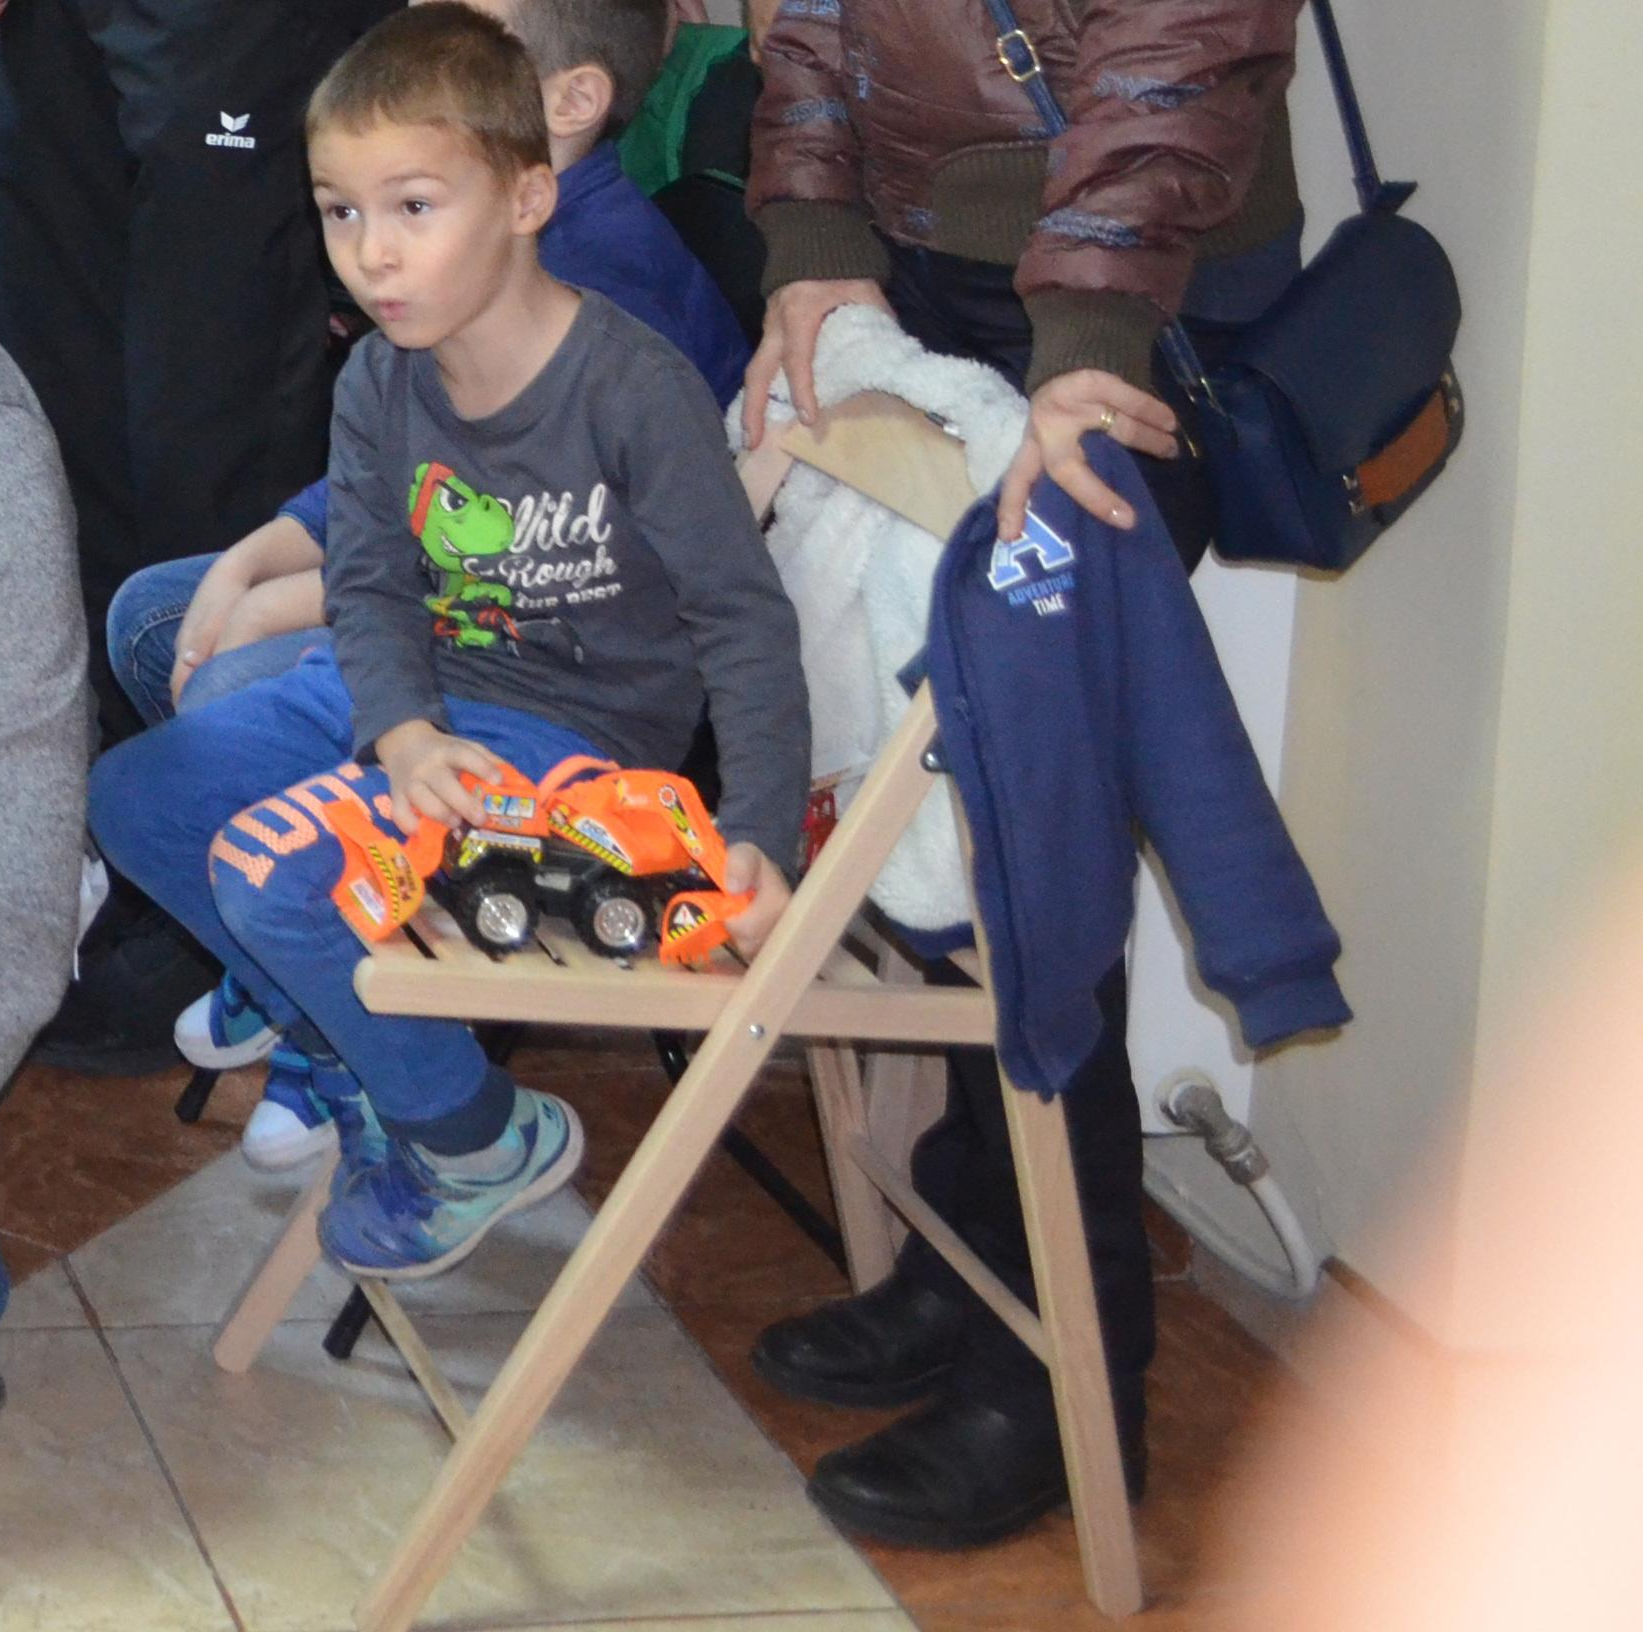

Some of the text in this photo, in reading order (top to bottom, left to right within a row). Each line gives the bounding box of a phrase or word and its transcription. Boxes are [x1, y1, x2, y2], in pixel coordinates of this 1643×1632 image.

[205, 132, 256, 150] erima
[497, 543, 618, 588] Rough
[1006, 571, 1077, 607] ADVENTURE
[1031, 593, 1067, 617] TIME
